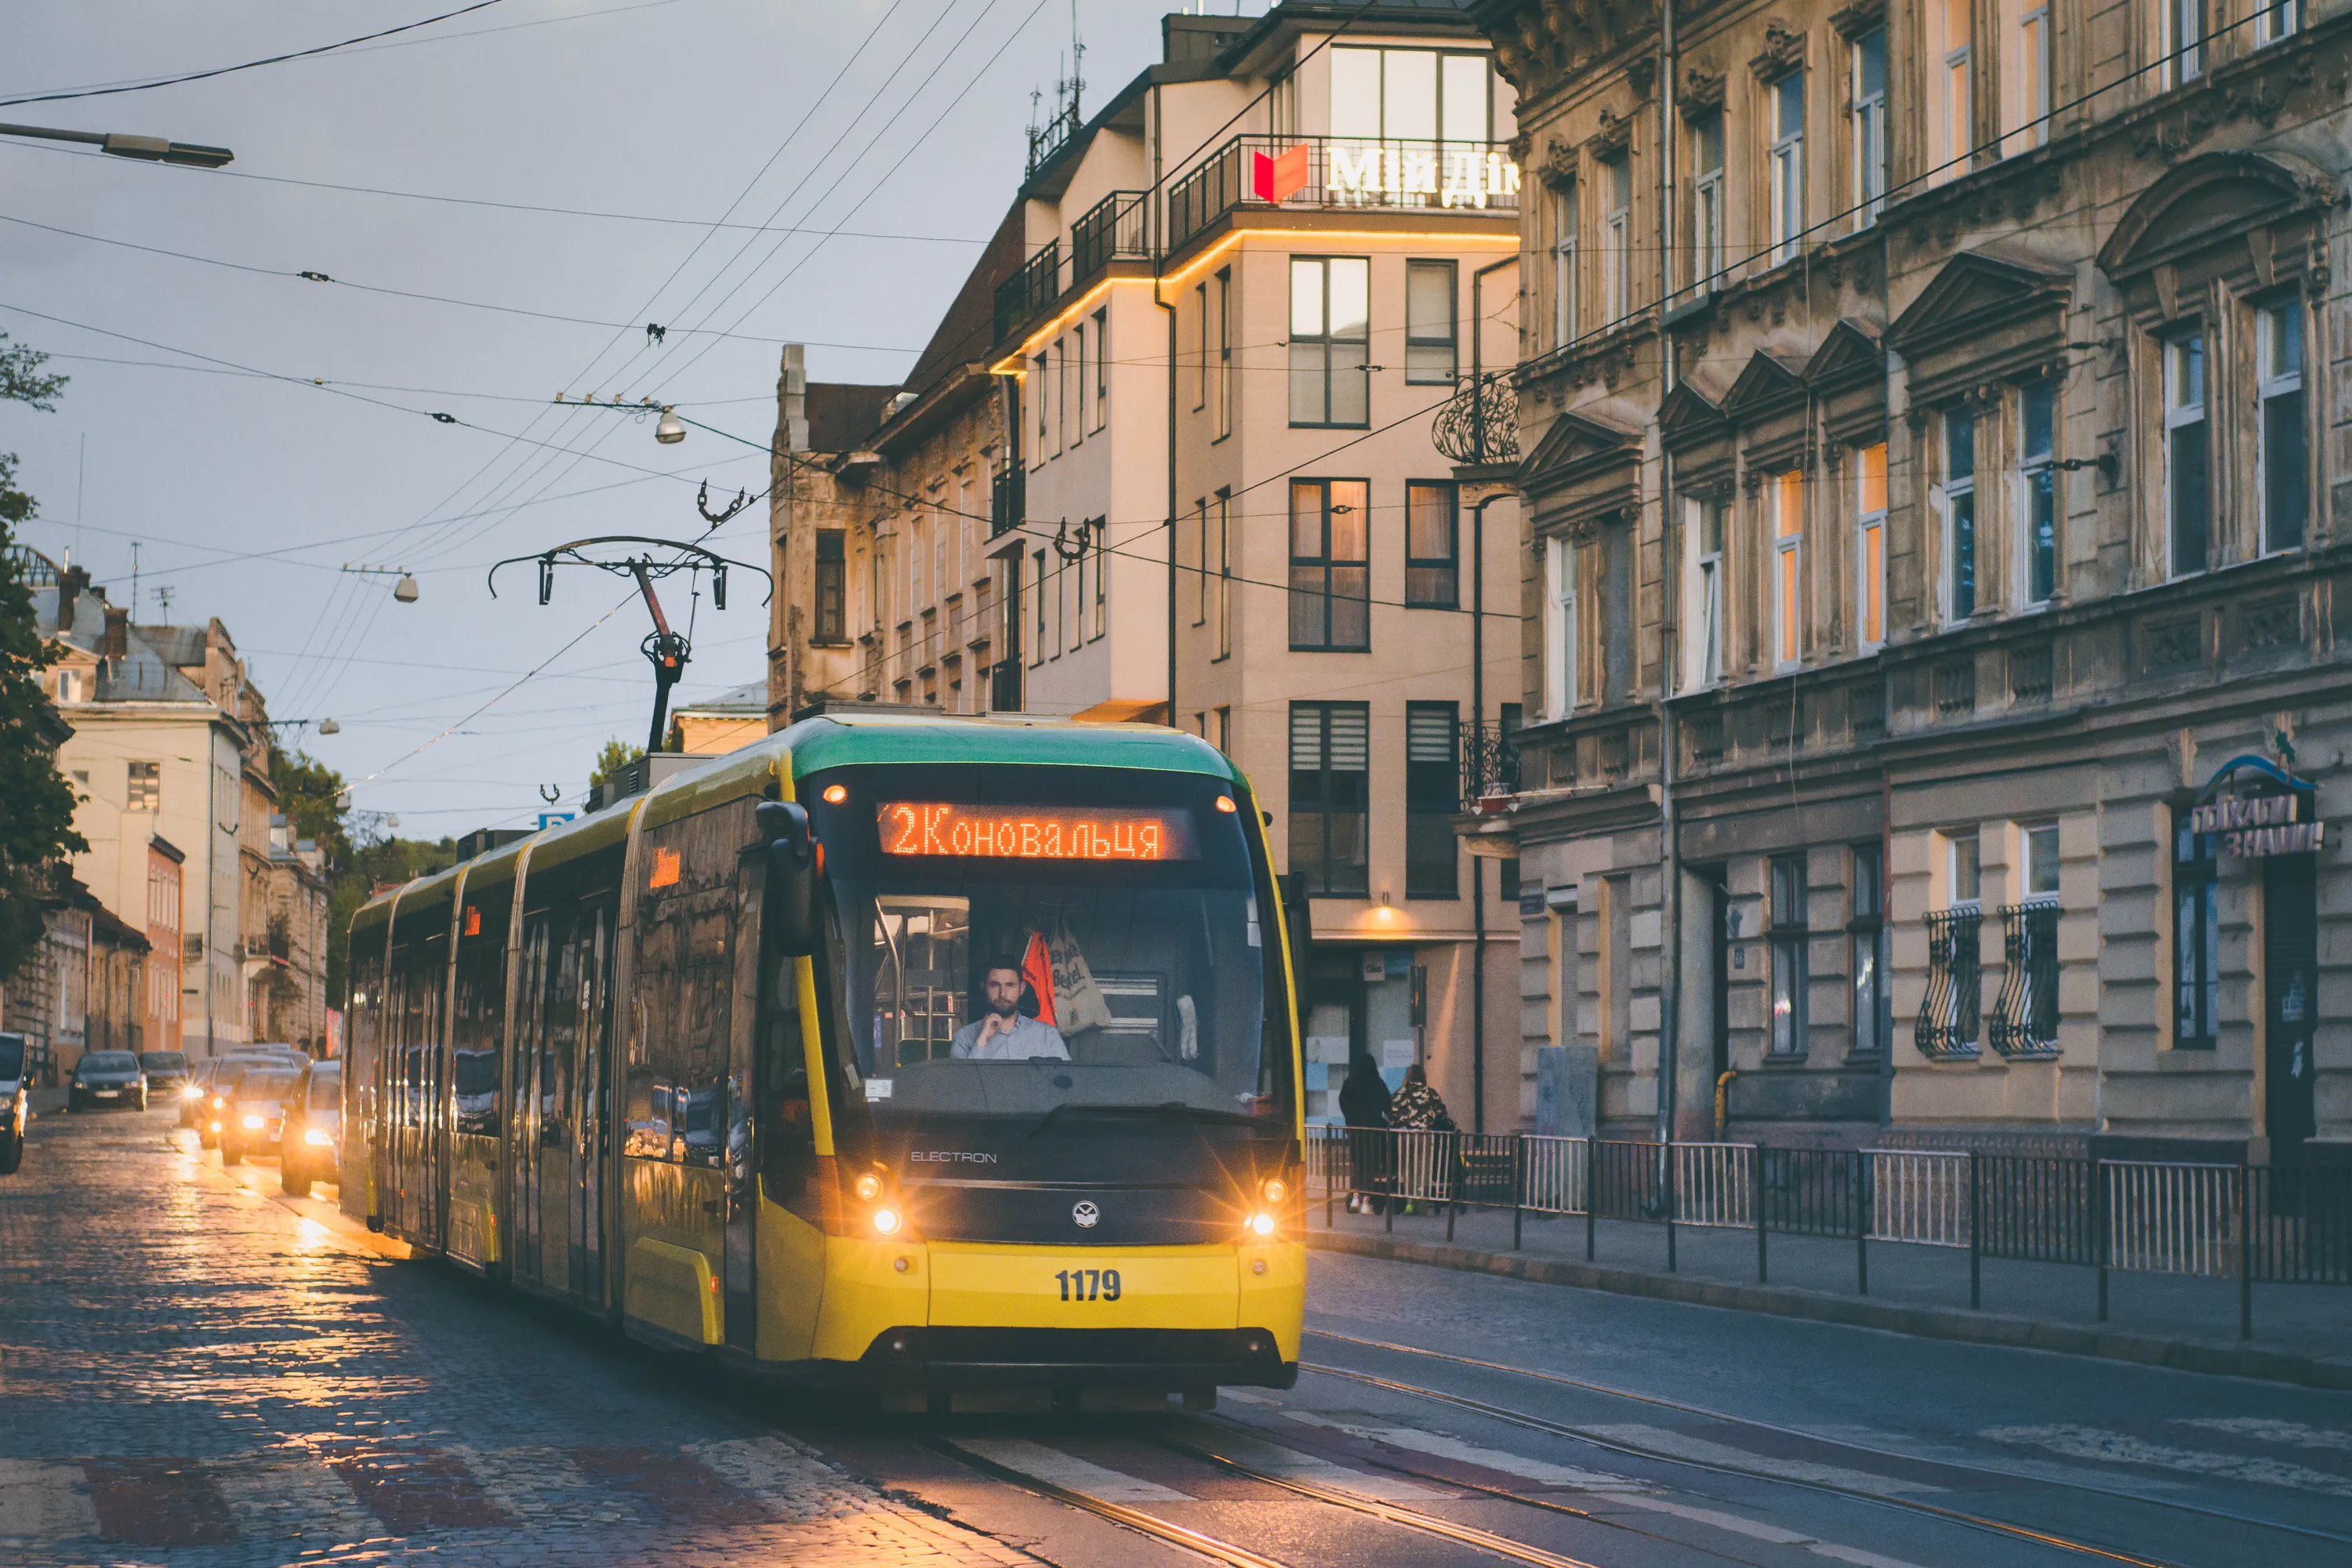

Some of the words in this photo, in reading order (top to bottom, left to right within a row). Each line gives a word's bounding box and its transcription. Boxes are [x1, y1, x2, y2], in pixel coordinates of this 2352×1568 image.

[1326, 146, 1438, 194] Мій
[911, 1151, 996, 1163] ELECTRON
[1054, 1269, 1120, 1301] 1179
